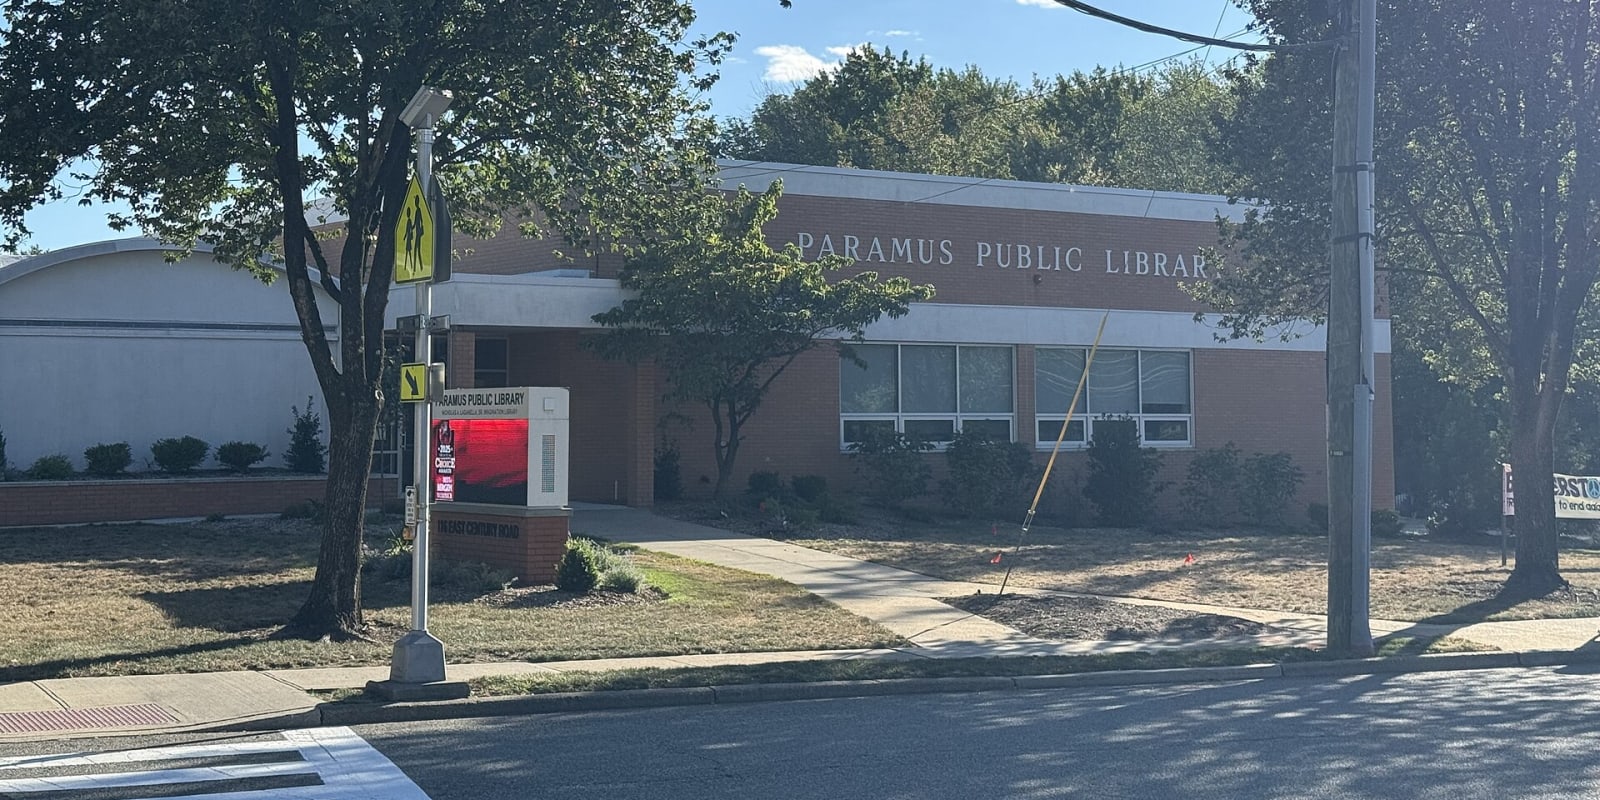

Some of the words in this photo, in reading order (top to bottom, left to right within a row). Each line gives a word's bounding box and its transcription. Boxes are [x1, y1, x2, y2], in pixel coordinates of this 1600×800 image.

[797, 232, 953, 266] PARAMUS
[976, 241, 1083, 272] PUBLIC
[1105, 249, 1222, 279] LIBRAR
[468, 393, 493, 406] PUBLIC
[494, 392, 525, 405] LIBRARY
[435, 457, 456, 469] CHOICE
[1558, 499, 1568, 510] to
[1569, 501, 1585, 511] end
[448, 519, 465, 535] EAST
[465, 520, 498, 538] CENTURY
[499, 523, 520, 540] ROAD
